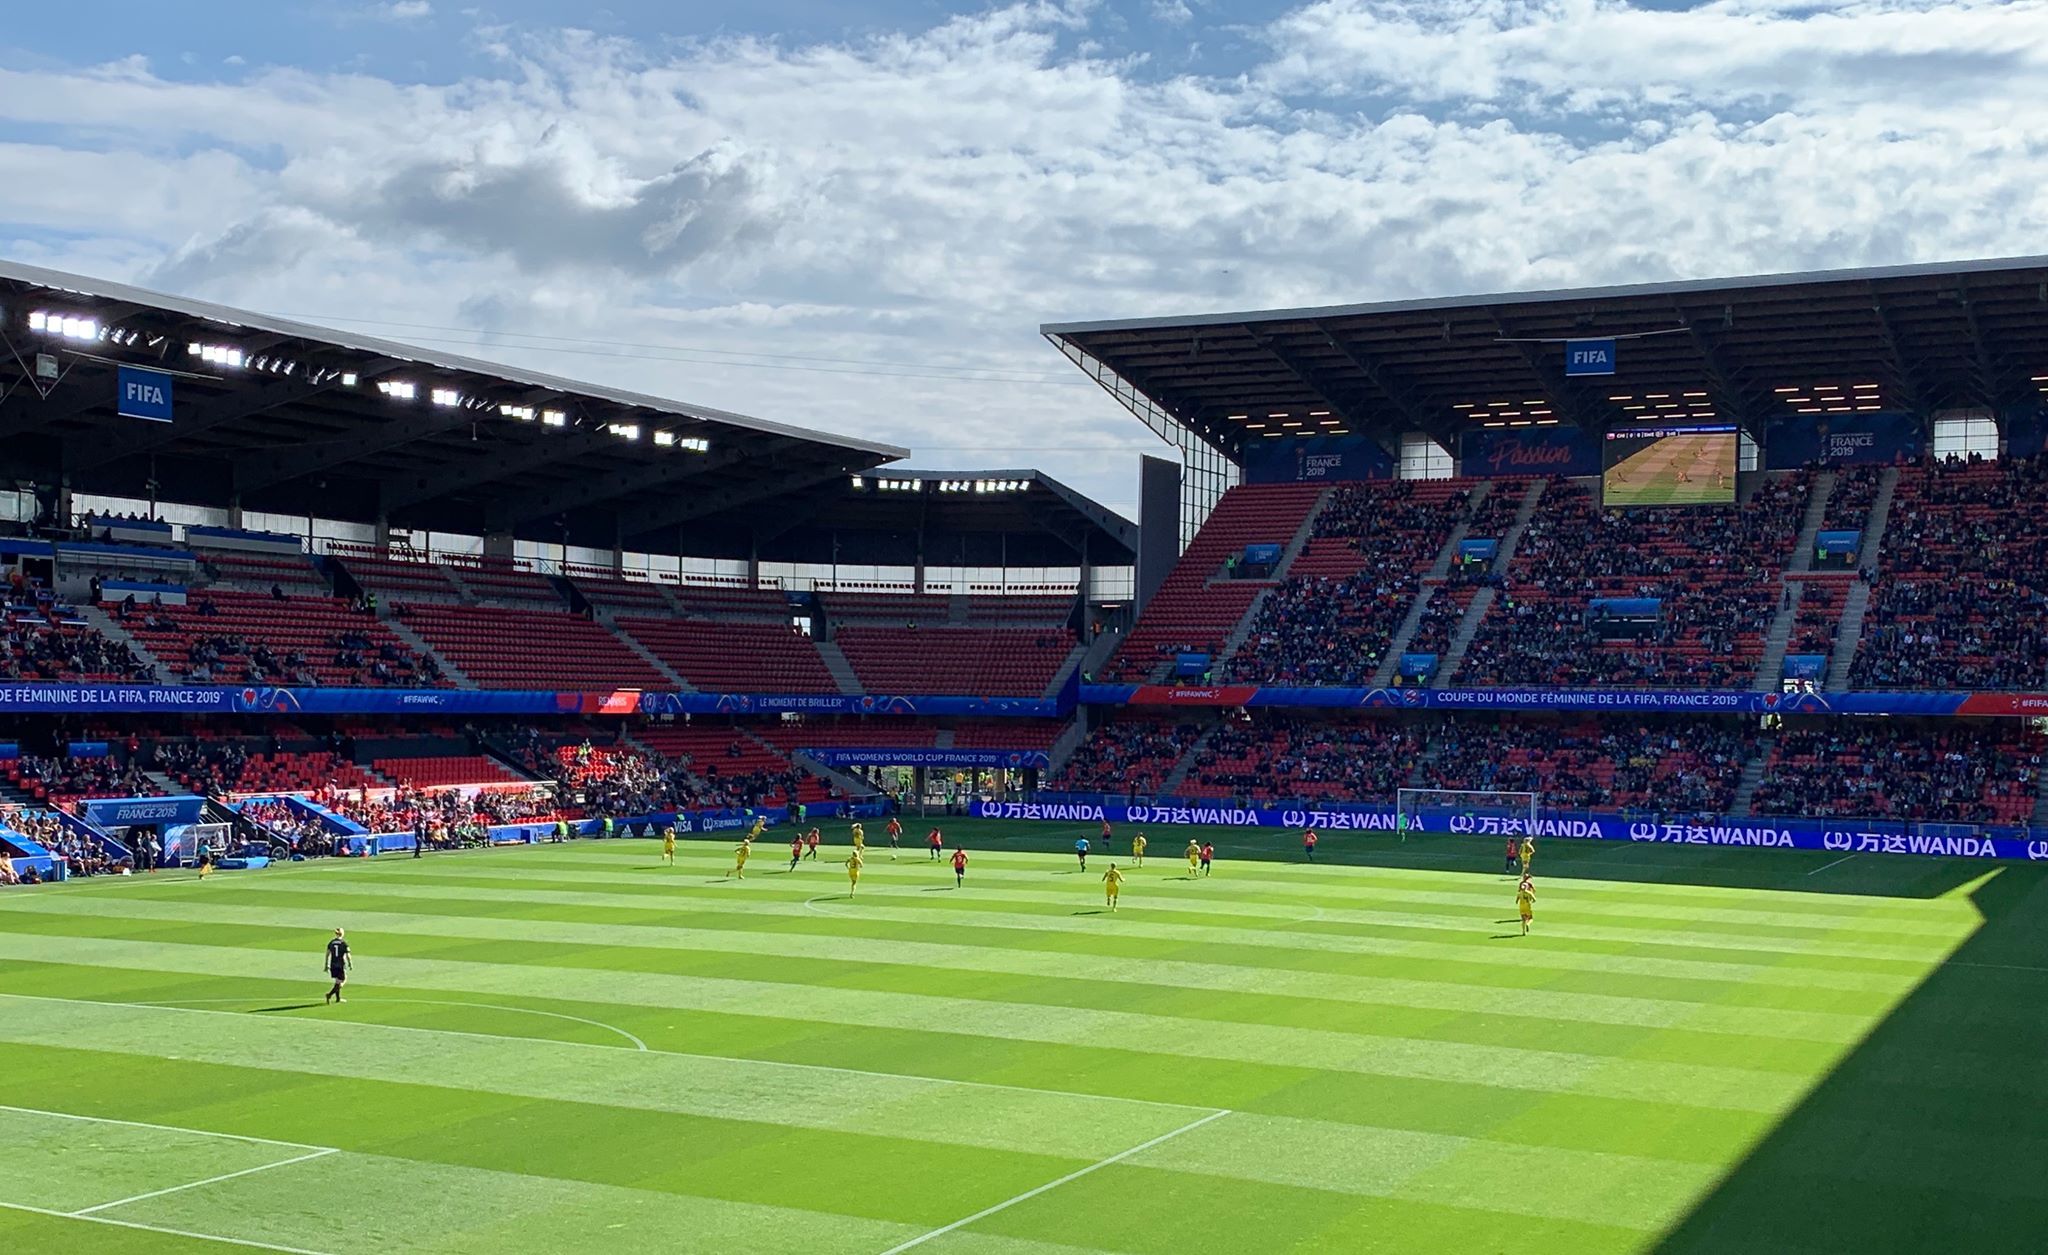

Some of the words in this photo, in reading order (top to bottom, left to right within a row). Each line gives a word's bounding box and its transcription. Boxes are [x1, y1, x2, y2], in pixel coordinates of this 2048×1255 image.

[1573, 350, 1607, 364] FIFA
[127, 382, 164, 405] FIFA
[1830, 436, 1874, 447] FRANCE
[1488, 439, 1572, 472] Passion
[1830, 446, 1854, 456] 2019
[1306, 457, 1341, 468] FRANCE
[1306, 467, 1326, 476] 2019
[15, 686, 79, 704] FÉMININE
[81, 689, 98, 703] DE
[100, 689, 117, 703] LA
[119, 690, 147, 704] FIFA,
[148, 690, 194, 704] FRANCE
[196, 691, 220, 704] 2019
[1175, 690, 1213, 698] #FIFAWWC
[1437, 692, 1475, 702] COUPE
[1477, 692, 1494, 703] DU
[1496, 693, 1538, 704] MONDE
[1540, 692, 1596, 705] FÉMININE
[1598, 694, 1614, 704] DE
[1616, 694, 1631, 704] LA
[1633, 694, 1661, 706] FIFA,
[1663, 695, 1710, 706] FRANCE
[1712, 695, 1738, 706] 2019
[836, 753, 851, 761] FIFA
[852, 753, 892, 762] WOMEN'S
[893, 753, 925, 762] WORLD
[925, 754, 944, 762] CUP
[945, 754, 977, 763] FRANCE
[978, 755, 997, 763] 2019
[116, 809, 154, 820] FRANCE
[155, 807, 177, 818] 2019
[673, 820, 692, 833] VISA
[333, 944, 339, 957] 1
